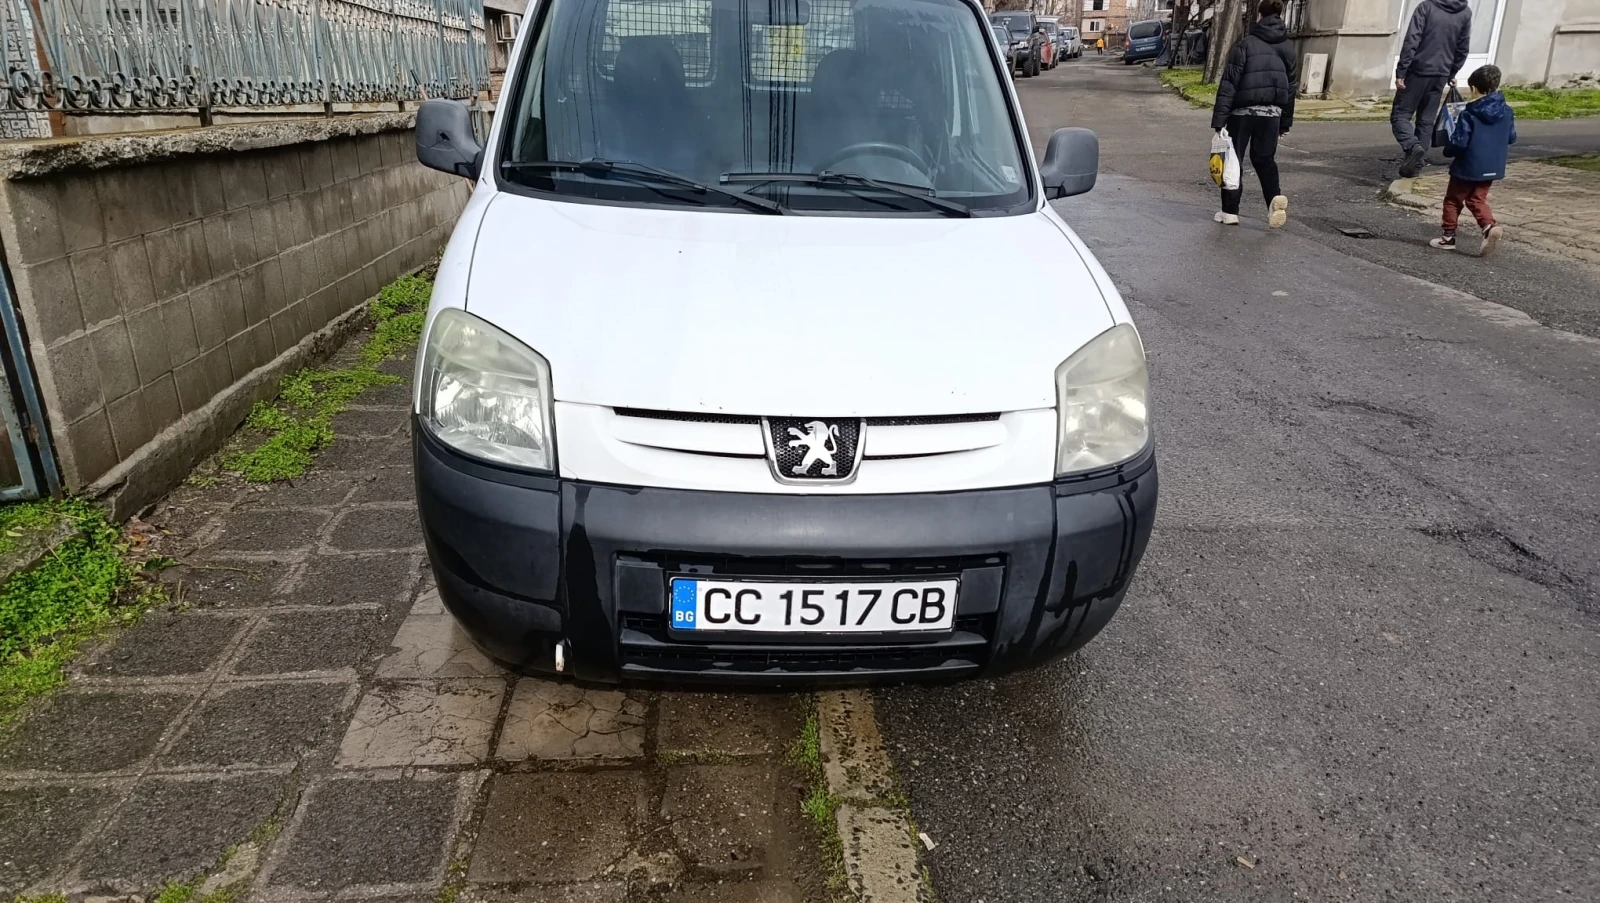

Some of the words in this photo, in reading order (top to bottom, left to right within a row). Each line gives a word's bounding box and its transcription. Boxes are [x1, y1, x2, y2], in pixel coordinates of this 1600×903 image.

[675, 610, 694, 622] BG
[704, 587, 762, 625] CC
[779, 589, 882, 626] 1517
[890, 587, 946, 625] CB
